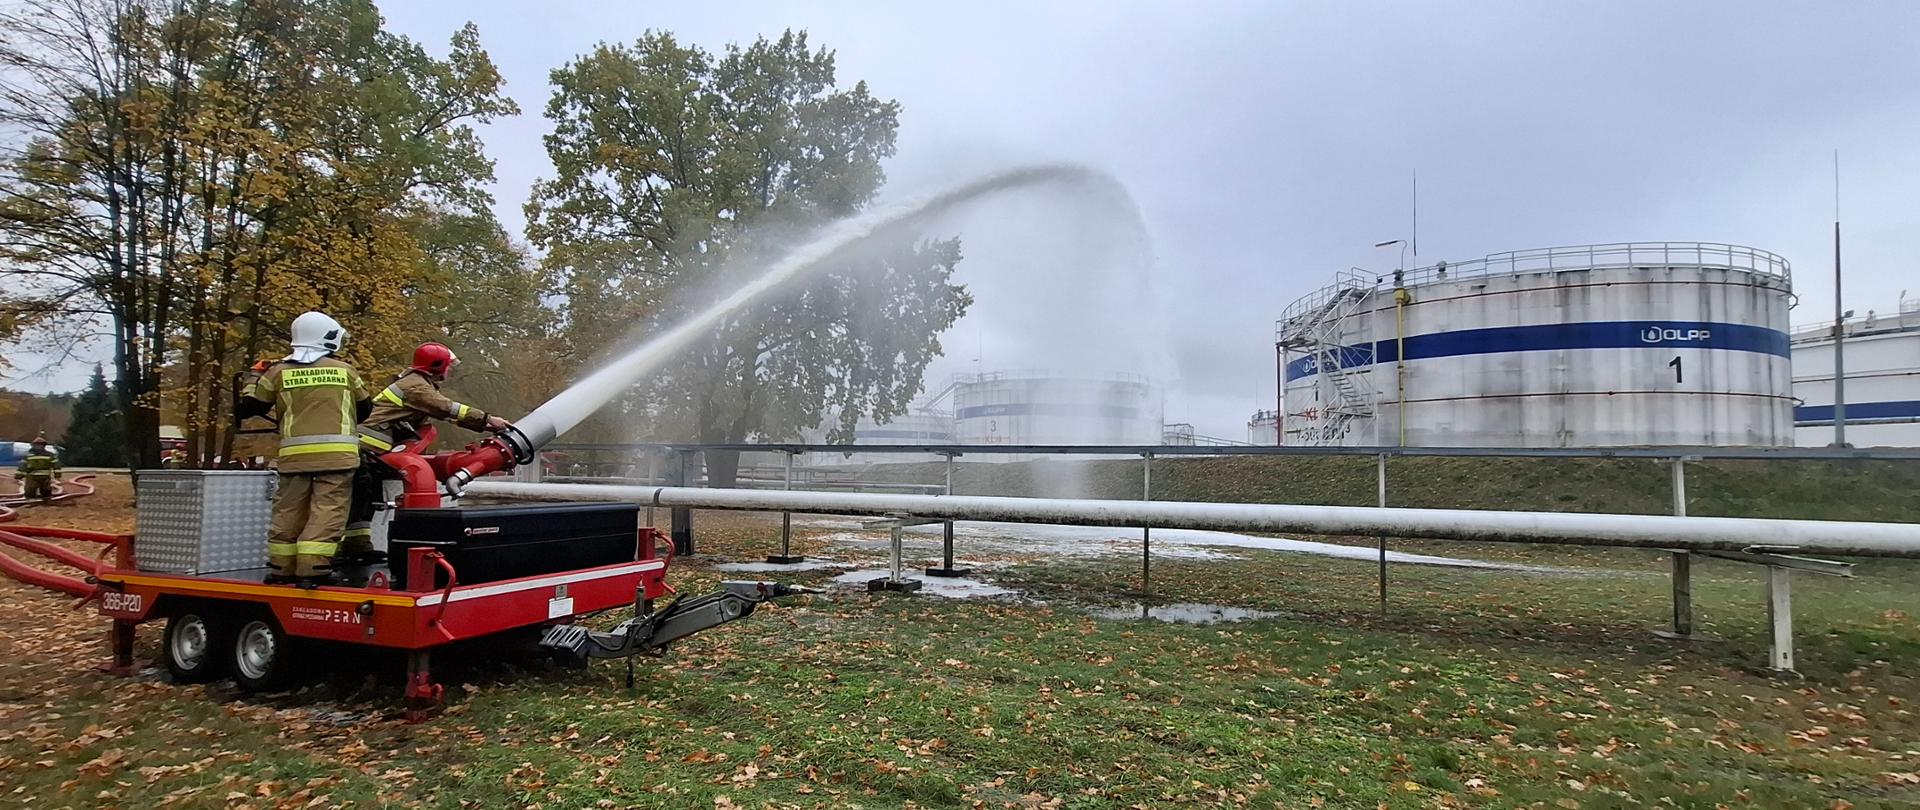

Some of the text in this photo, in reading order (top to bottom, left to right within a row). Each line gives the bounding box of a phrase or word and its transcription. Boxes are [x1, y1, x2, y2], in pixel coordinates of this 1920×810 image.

[1663, 329, 1711, 341] OLPP
[291, 369, 338, 377] ZAKŁADOWA
[1668, 356, 1683, 383] 1
[990, 420, 997, 432] 3
[103, 591, 142, 613] 366-P20
[325, 609, 361, 625] PERN
